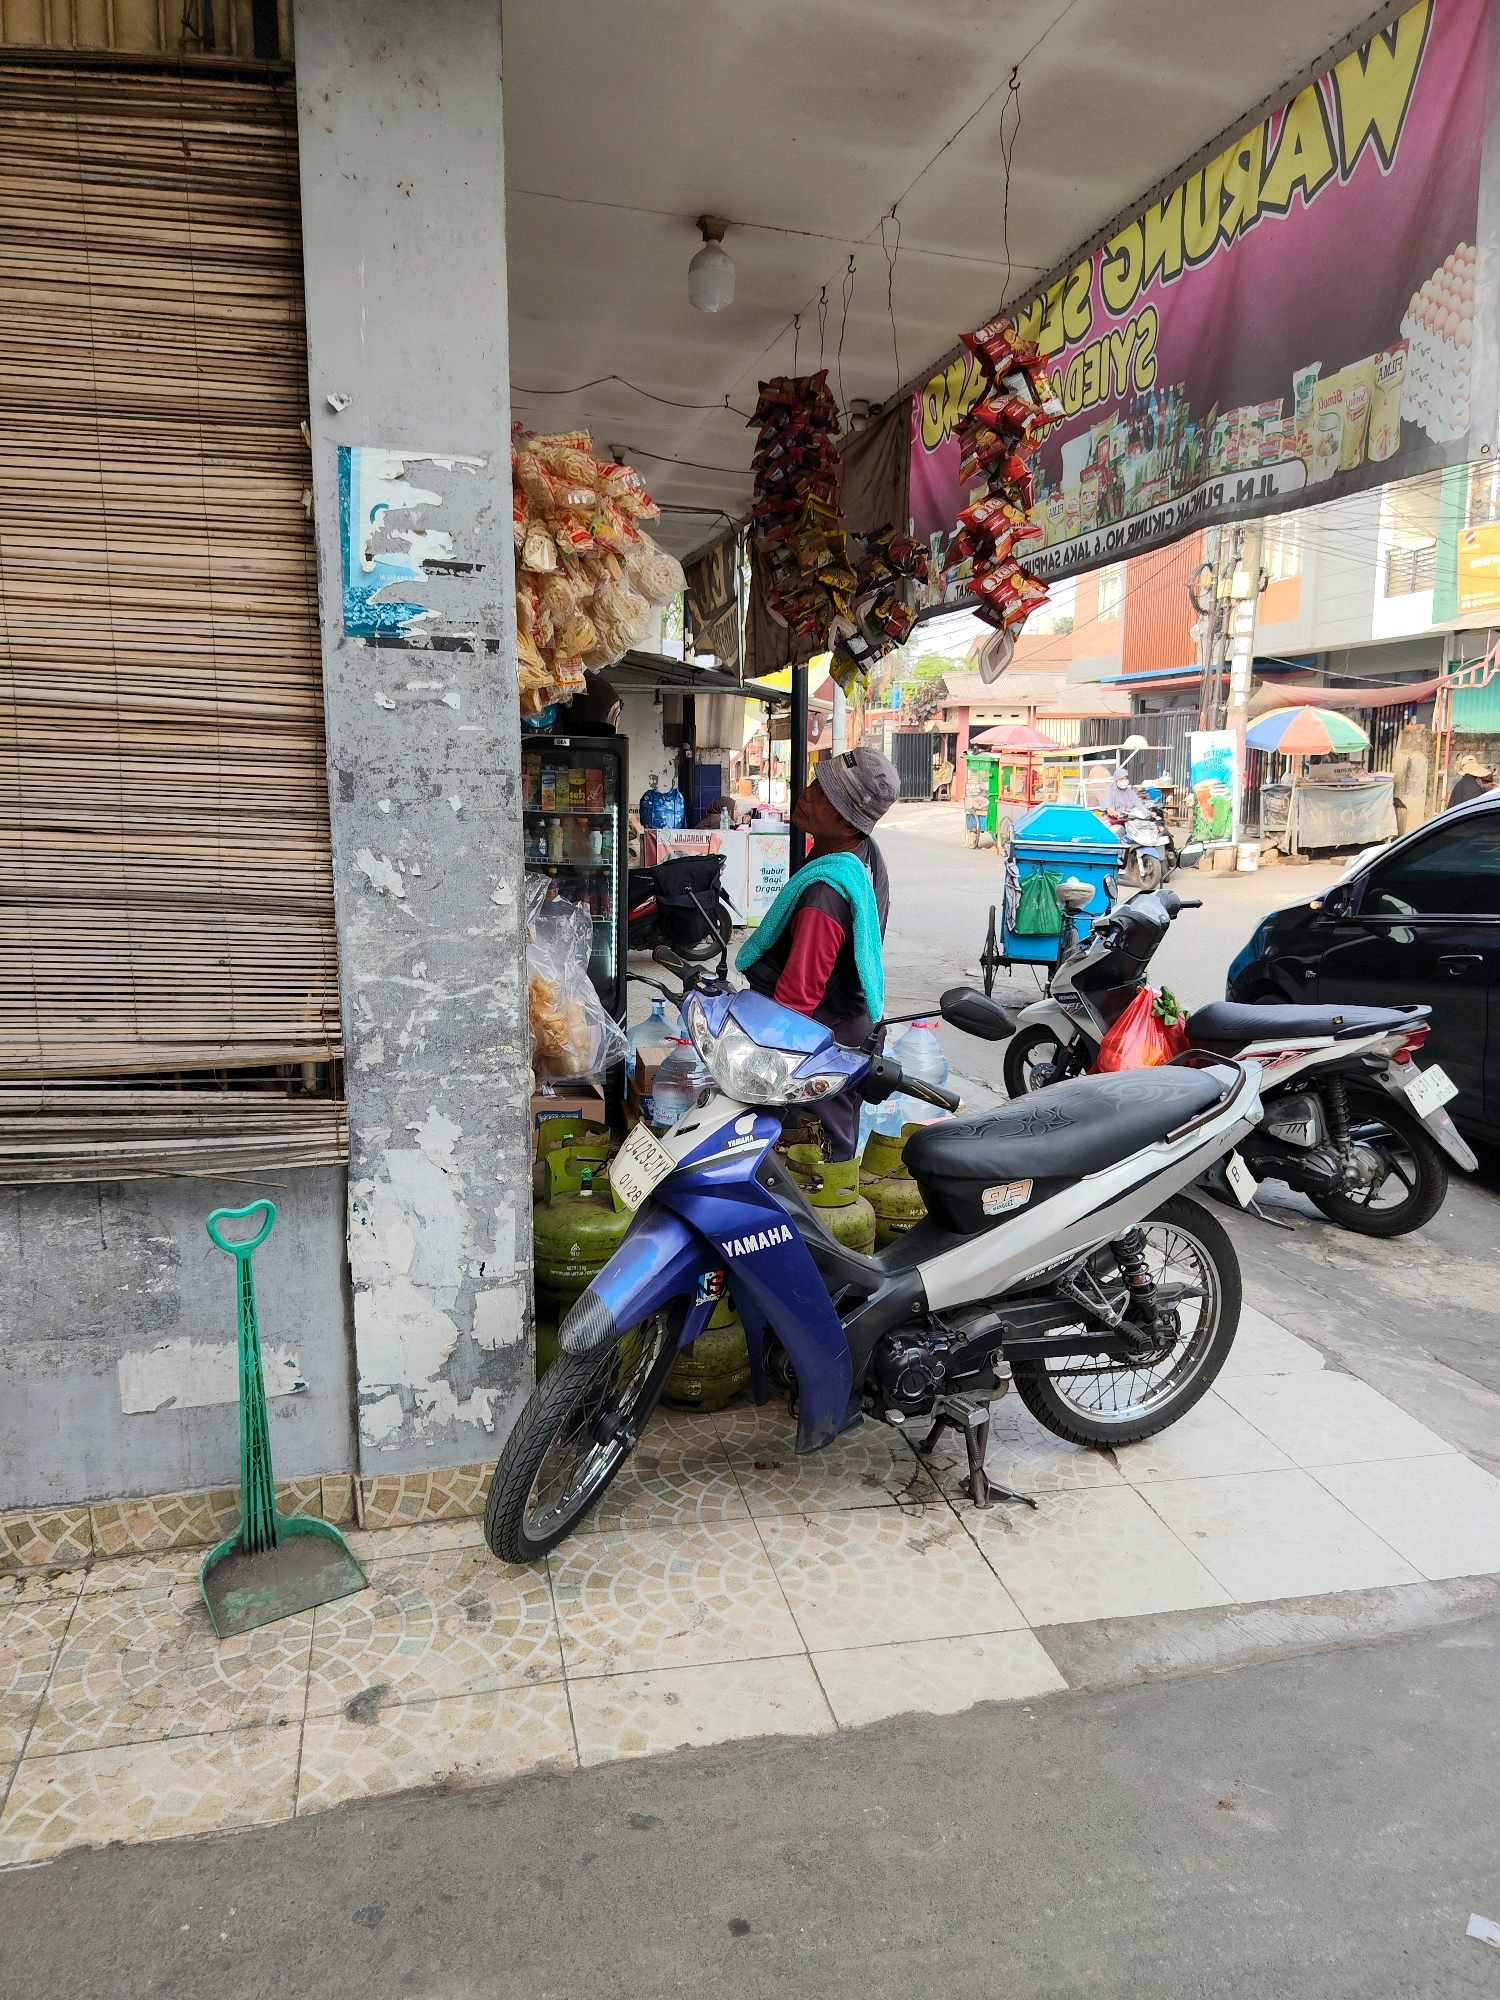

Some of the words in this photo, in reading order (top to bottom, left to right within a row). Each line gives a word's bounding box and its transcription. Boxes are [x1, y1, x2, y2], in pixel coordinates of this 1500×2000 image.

[1308, 808, 1370, 827] MUQA
[759, 867, 785, 876] Bubur
[762, 875, 783, 884] Bayi
[727, 1134, 754, 1148] YAMAHA
[721, 1224, 794, 1258] YAMAHA
